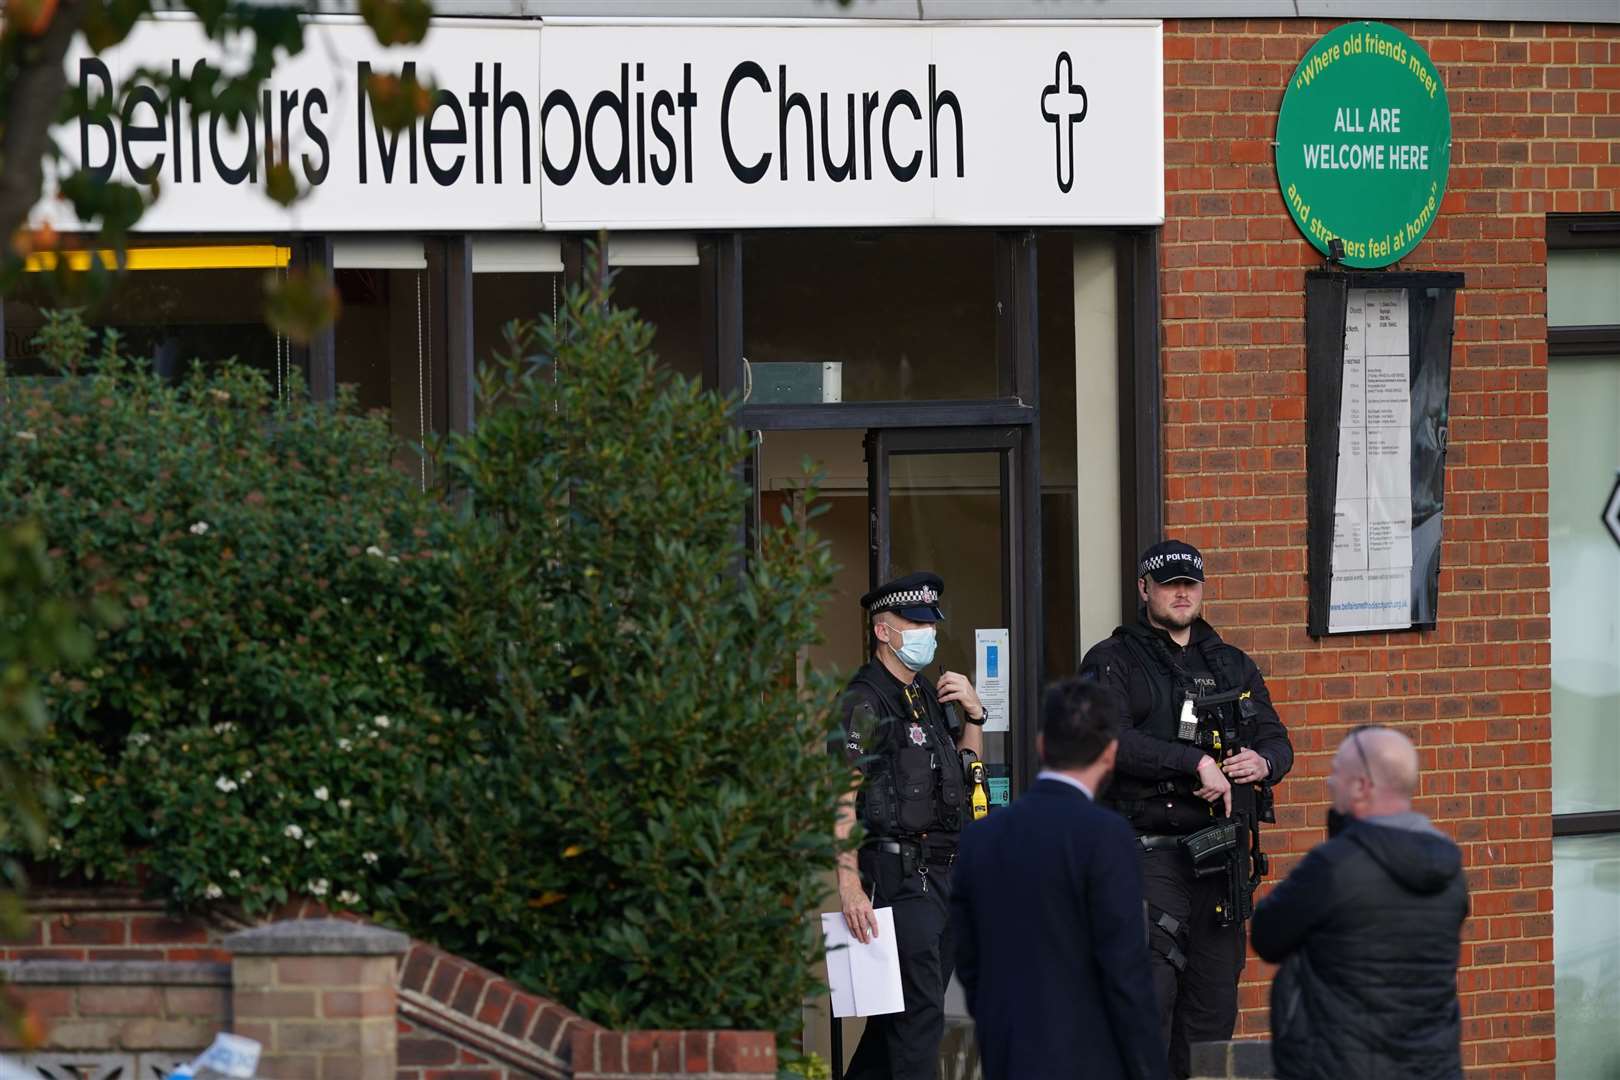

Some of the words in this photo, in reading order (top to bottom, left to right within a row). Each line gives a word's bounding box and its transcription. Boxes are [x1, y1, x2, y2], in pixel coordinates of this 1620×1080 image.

[1343, 33, 1362, 56] old
[1365, 32, 1407, 65] friends
[1408, 55, 1437, 99] meet
[357, 61, 698, 186] Methodist
[720, 61, 965, 184] Church
[1333, 107, 1365, 133] ALL
[1368, 107, 1401, 133] ARE
[1302, 144, 1384, 170] WELCOME
[1389, 144, 1429, 170] HERE
[1287, 183, 1311, 223] and
[1309, 217, 1366, 258] straers
[1368, 234, 1391, 258] feel
[1393, 230, 1405, 252] at
[1166, 553, 1193, 561] POLICE
[1193, 678, 1217, 687] POLICE
